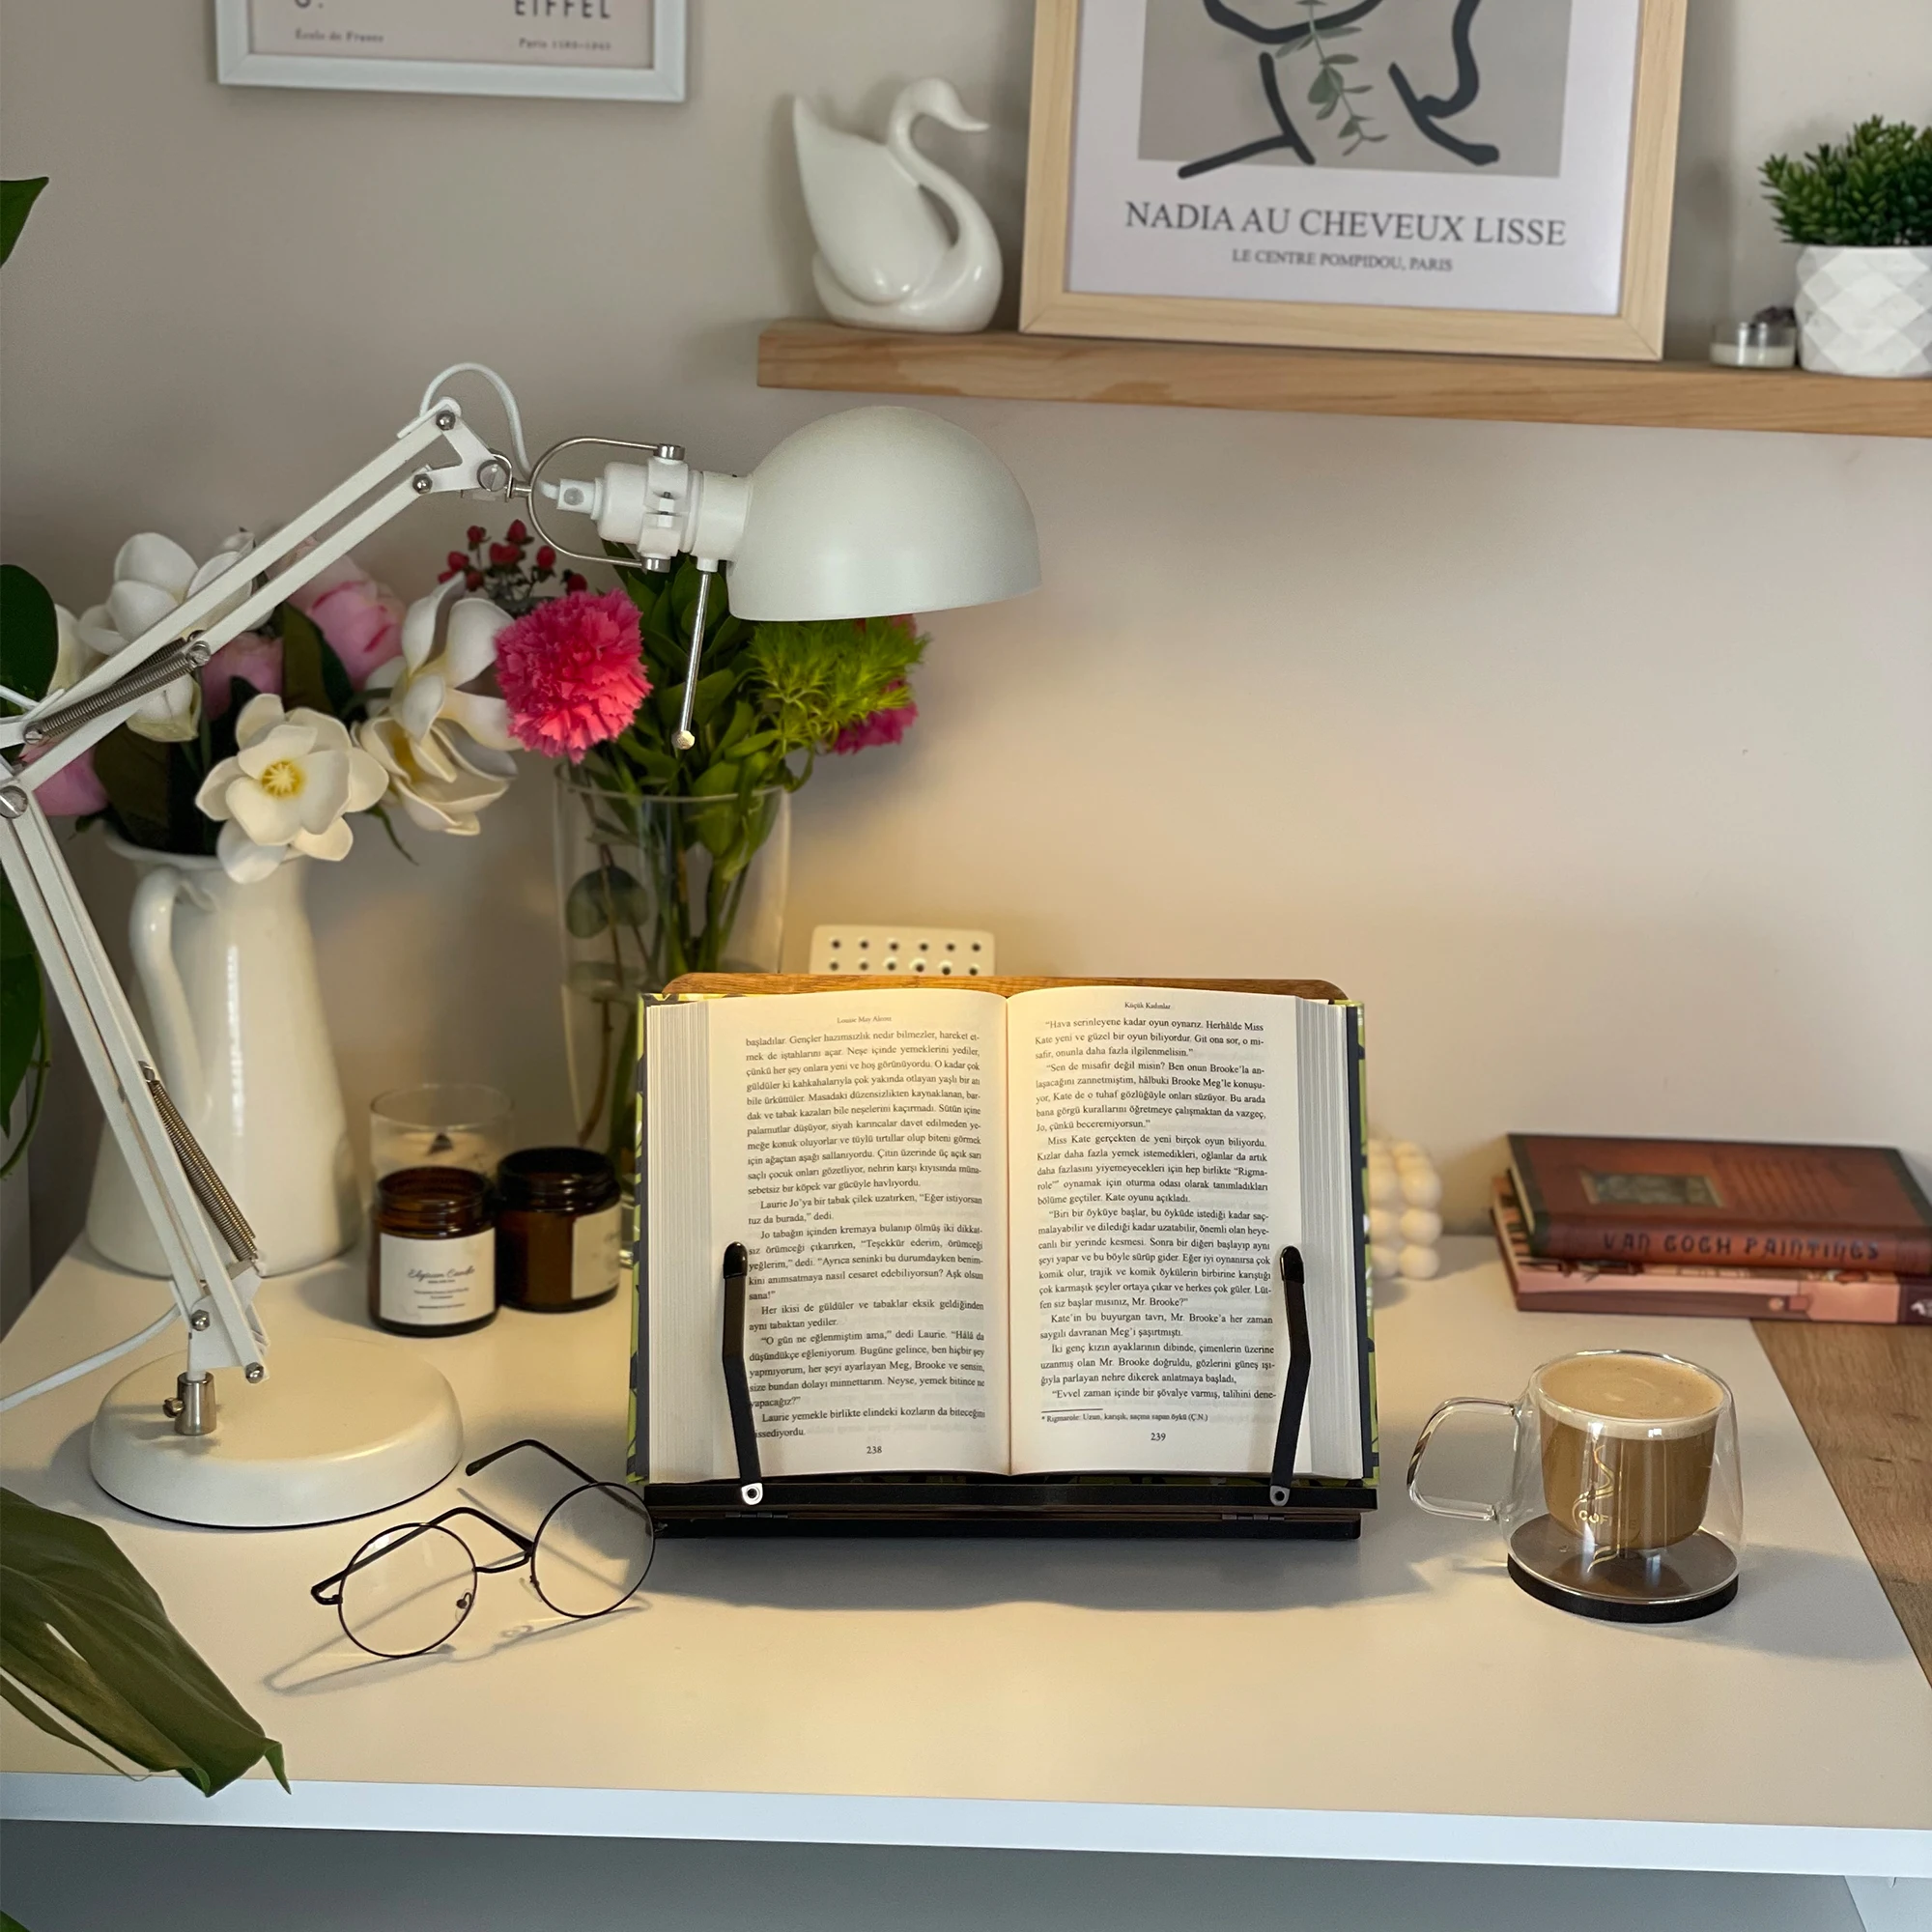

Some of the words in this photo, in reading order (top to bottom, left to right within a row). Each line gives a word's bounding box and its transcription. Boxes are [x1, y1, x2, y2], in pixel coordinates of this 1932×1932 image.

[515, 0, 611, 18] EIFFEL
[1125, 200, 1235, 232] NADIA
[1240, 207, 1291, 235] AU
[1299, 208, 1464, 242] CHEVEUX
[1474, 215, 1567, 246] LISSE
[1232, 248, 1251, 263] LE
[1255, 249, 1316, 267] CENTRE
[1320, 252, 1406, 271] POMPIDOU,
[1409, 255, 1453, 272] PARIS
[789, 1035, 821, 1044] Gençler
[939, 1030, 967, 1039] hareket
[746, 1081, 781, 1092] güldüler
[854, 1075, 868, 1085] çok
[906, 1074, 936, 1084] otlayan
[959, 1075, 969, 1084] bir
[1057, 1106, 1080, 1117] görgü
[1129, 1105, 1172, 1115] öğretmeye
[747, 1124, 790, 1137] palamutlar
[831, 1121, 852, 1131] siyah
[925, 1119, 967, 1127] edilmeden
[748, 1142, 769, 1151] meğe
[772, 1139, 797, 1149] konuk
[800, 1136, 837, 1148] oluyorlar
[852, 1134, 873, 1145] tüylü
[906, 1133, 925, 1144] olup
[927, 1133, 951, 1142] biteni
[953, 1135, 980, 1144] görmek
[1048, 1136, 1066, 1145] Miss
[1071, 1134, 1091, 1143] Kate
[1094, 1133, 1136, 1144] gerçekten
[1153, 1134, 1171, 1145] yeni
[1175, 1134, 1201, 1145] birçok
[1204, 1138, 1224, 1147] oyun
[1064, 1150, 1084, 1158] daha
[1088, 1149, 1107, 1157] fazla
[1111, 1149, 1139, 1158] yemek
[1201, 1151, 1233, 1161] oğlanlar
[1236, 1151, 1245, 1160] da
[768, 1169, 793, 1179] çocuk
[796, 1181, 820, 1193] köpek
[838, 1179, 870, 1190] gücüyle
[1037, 1196, 1066, 1205] bölüme
[1105, 1192, 1124, 1201] Kate
[1127, 1194, 1153, 1203] oyunu
[1602, 1233, 1651, 1252] VAN
[1663, 1235, 1731, 1255] GOGH
[1744, 1236, 1880, 1262] PAINTINGS
[1038, 1257, 1053, 1265] şeyi
[1056, 1255, 1079, 1264] yapar
[1094, 1252, 1104, 1261] bu
[1106, 1252, 1129, 1263] böyle
[1132, 1252, 1155, 1263] sürüp
[1182, 1253, 1201, 1264] Eğer
[1204, 1254, 1213, 1264] iyi
[1256, 1256, 1270, 1265] çok
[1052, 1343, 1063, 1352] İki
[1065, 1345, 1084, 1354] genç
[1199, 1344, 1241, 1353] çimenlerin
[1244, 1345, 1273, 1353] üzerine
[808, 1364, 821, 1373] her
[824, 1365, 841, 1374] şeyi
[844, 1361, 886, 1373] ayarlayan
[914, 1360, 945, 1369] Brooke
[1077, 1357, 1095, 1367] olan
[1119, 1356, 1150, 1366] Brooke
[1196, 1358, 1231, 1369] gözlerini
[1235, 1360, 1258, 1370] güneş
[1063, 1374, 1098, 1384] parlayan
[1101, 1372, 1124, 1381] nehre
[1127, 1372, 1159, 1381] dikerek
[1161, 1373, 1203, 1383] anlatmaya
[761, 1413, 789, 1422] Laurie
[791, 1410, 827, 1422] yemekle
[830, 1408, 861, 1418] birlikte
[863, 1406, 897, 1416] elindeki
[937, 1406, 947, 1415] da
[1151, 1432, 1167, 1442] 239
[866, 1445, 883, 1455] 238
